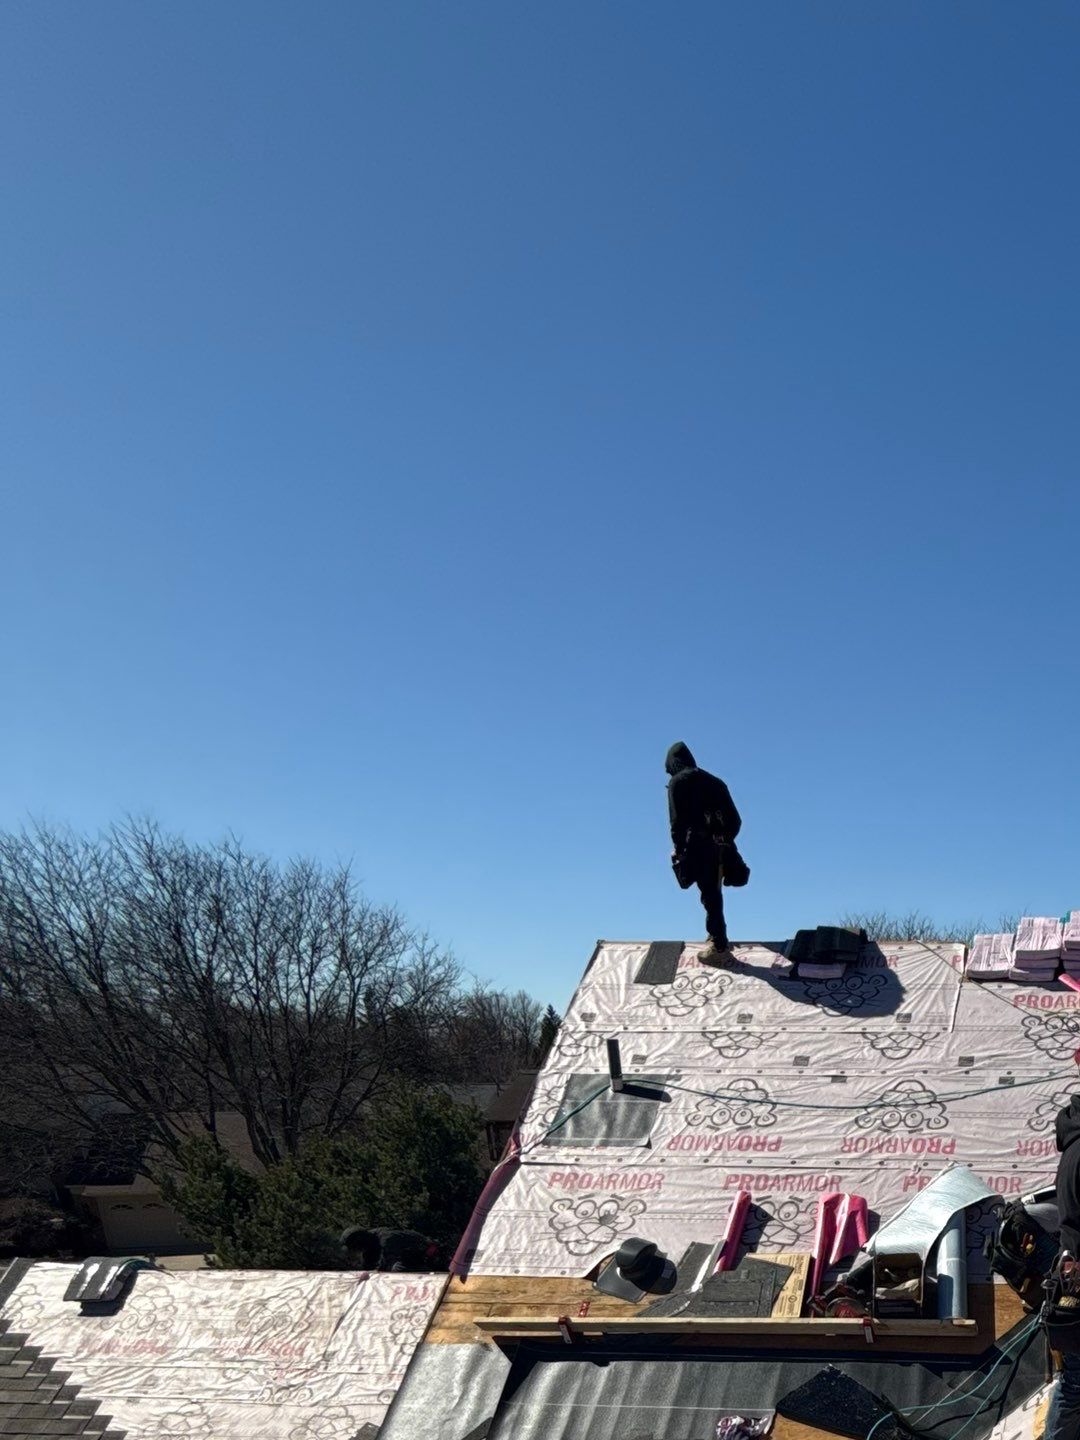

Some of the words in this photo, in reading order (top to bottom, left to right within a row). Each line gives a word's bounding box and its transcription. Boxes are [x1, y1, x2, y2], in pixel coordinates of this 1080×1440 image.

[668, 1135, 783, 1152] PROARMOR
[841, 1137, 956, 1155] PROARMOR
[548, 1172, 665, 1190] PROARMOR
[724, 1174, 842, 1192] PROARMOR
